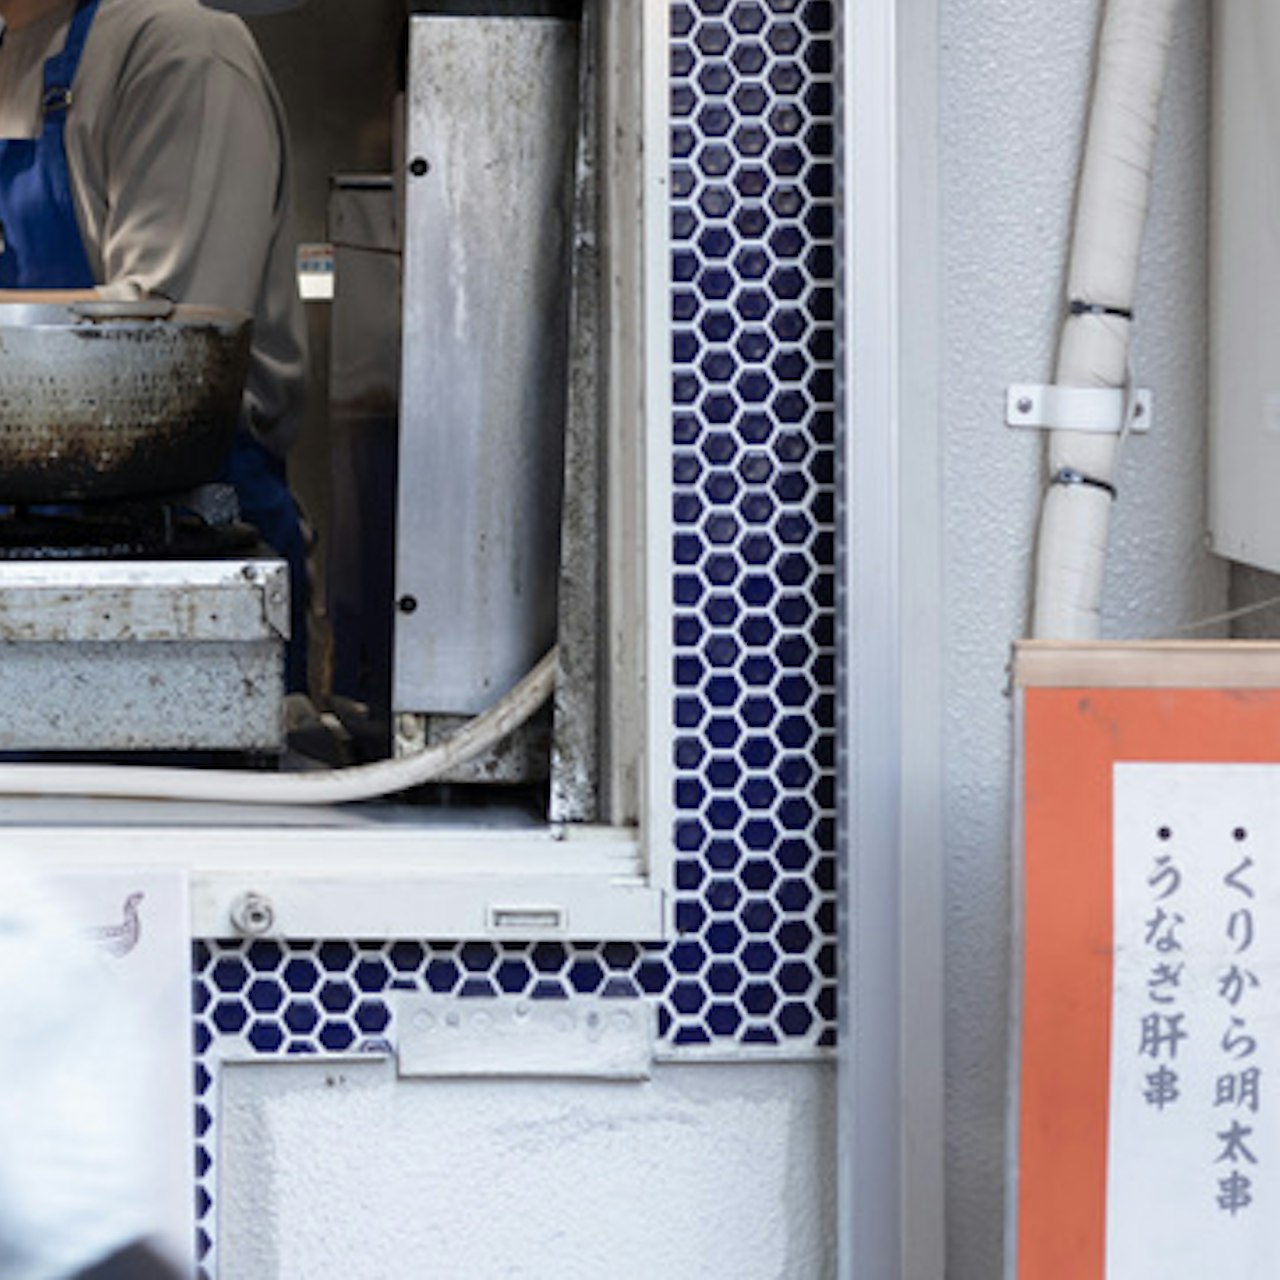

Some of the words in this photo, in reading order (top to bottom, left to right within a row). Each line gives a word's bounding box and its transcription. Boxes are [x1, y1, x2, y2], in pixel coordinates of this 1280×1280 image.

[1139, 854, 1187, 1112] うなぎ肝串
[1213, 856, 1262, 1216] くりから明太串
